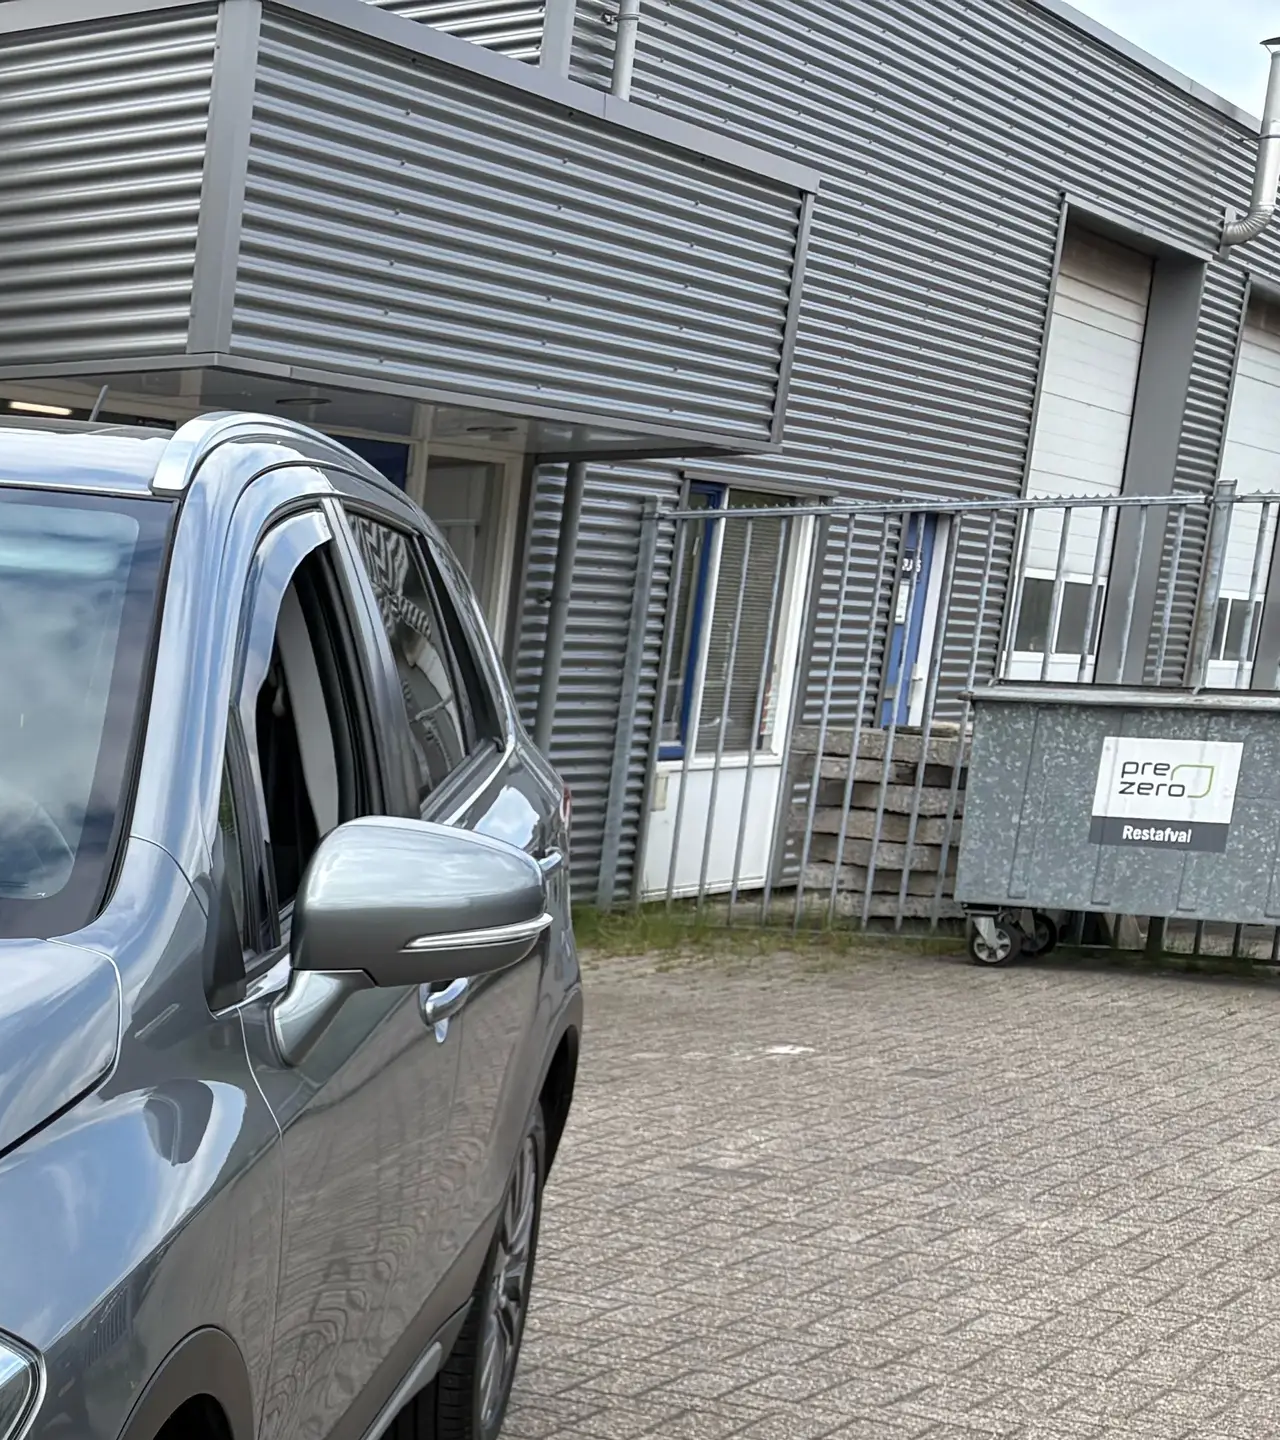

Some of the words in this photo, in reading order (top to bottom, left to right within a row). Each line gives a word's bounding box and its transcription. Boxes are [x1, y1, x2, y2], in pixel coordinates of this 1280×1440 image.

[1121, 761, 1171, 779] pre
[1118, 781, 1186, 797] zero
[1122, 825, 1192, 844] Restafval
